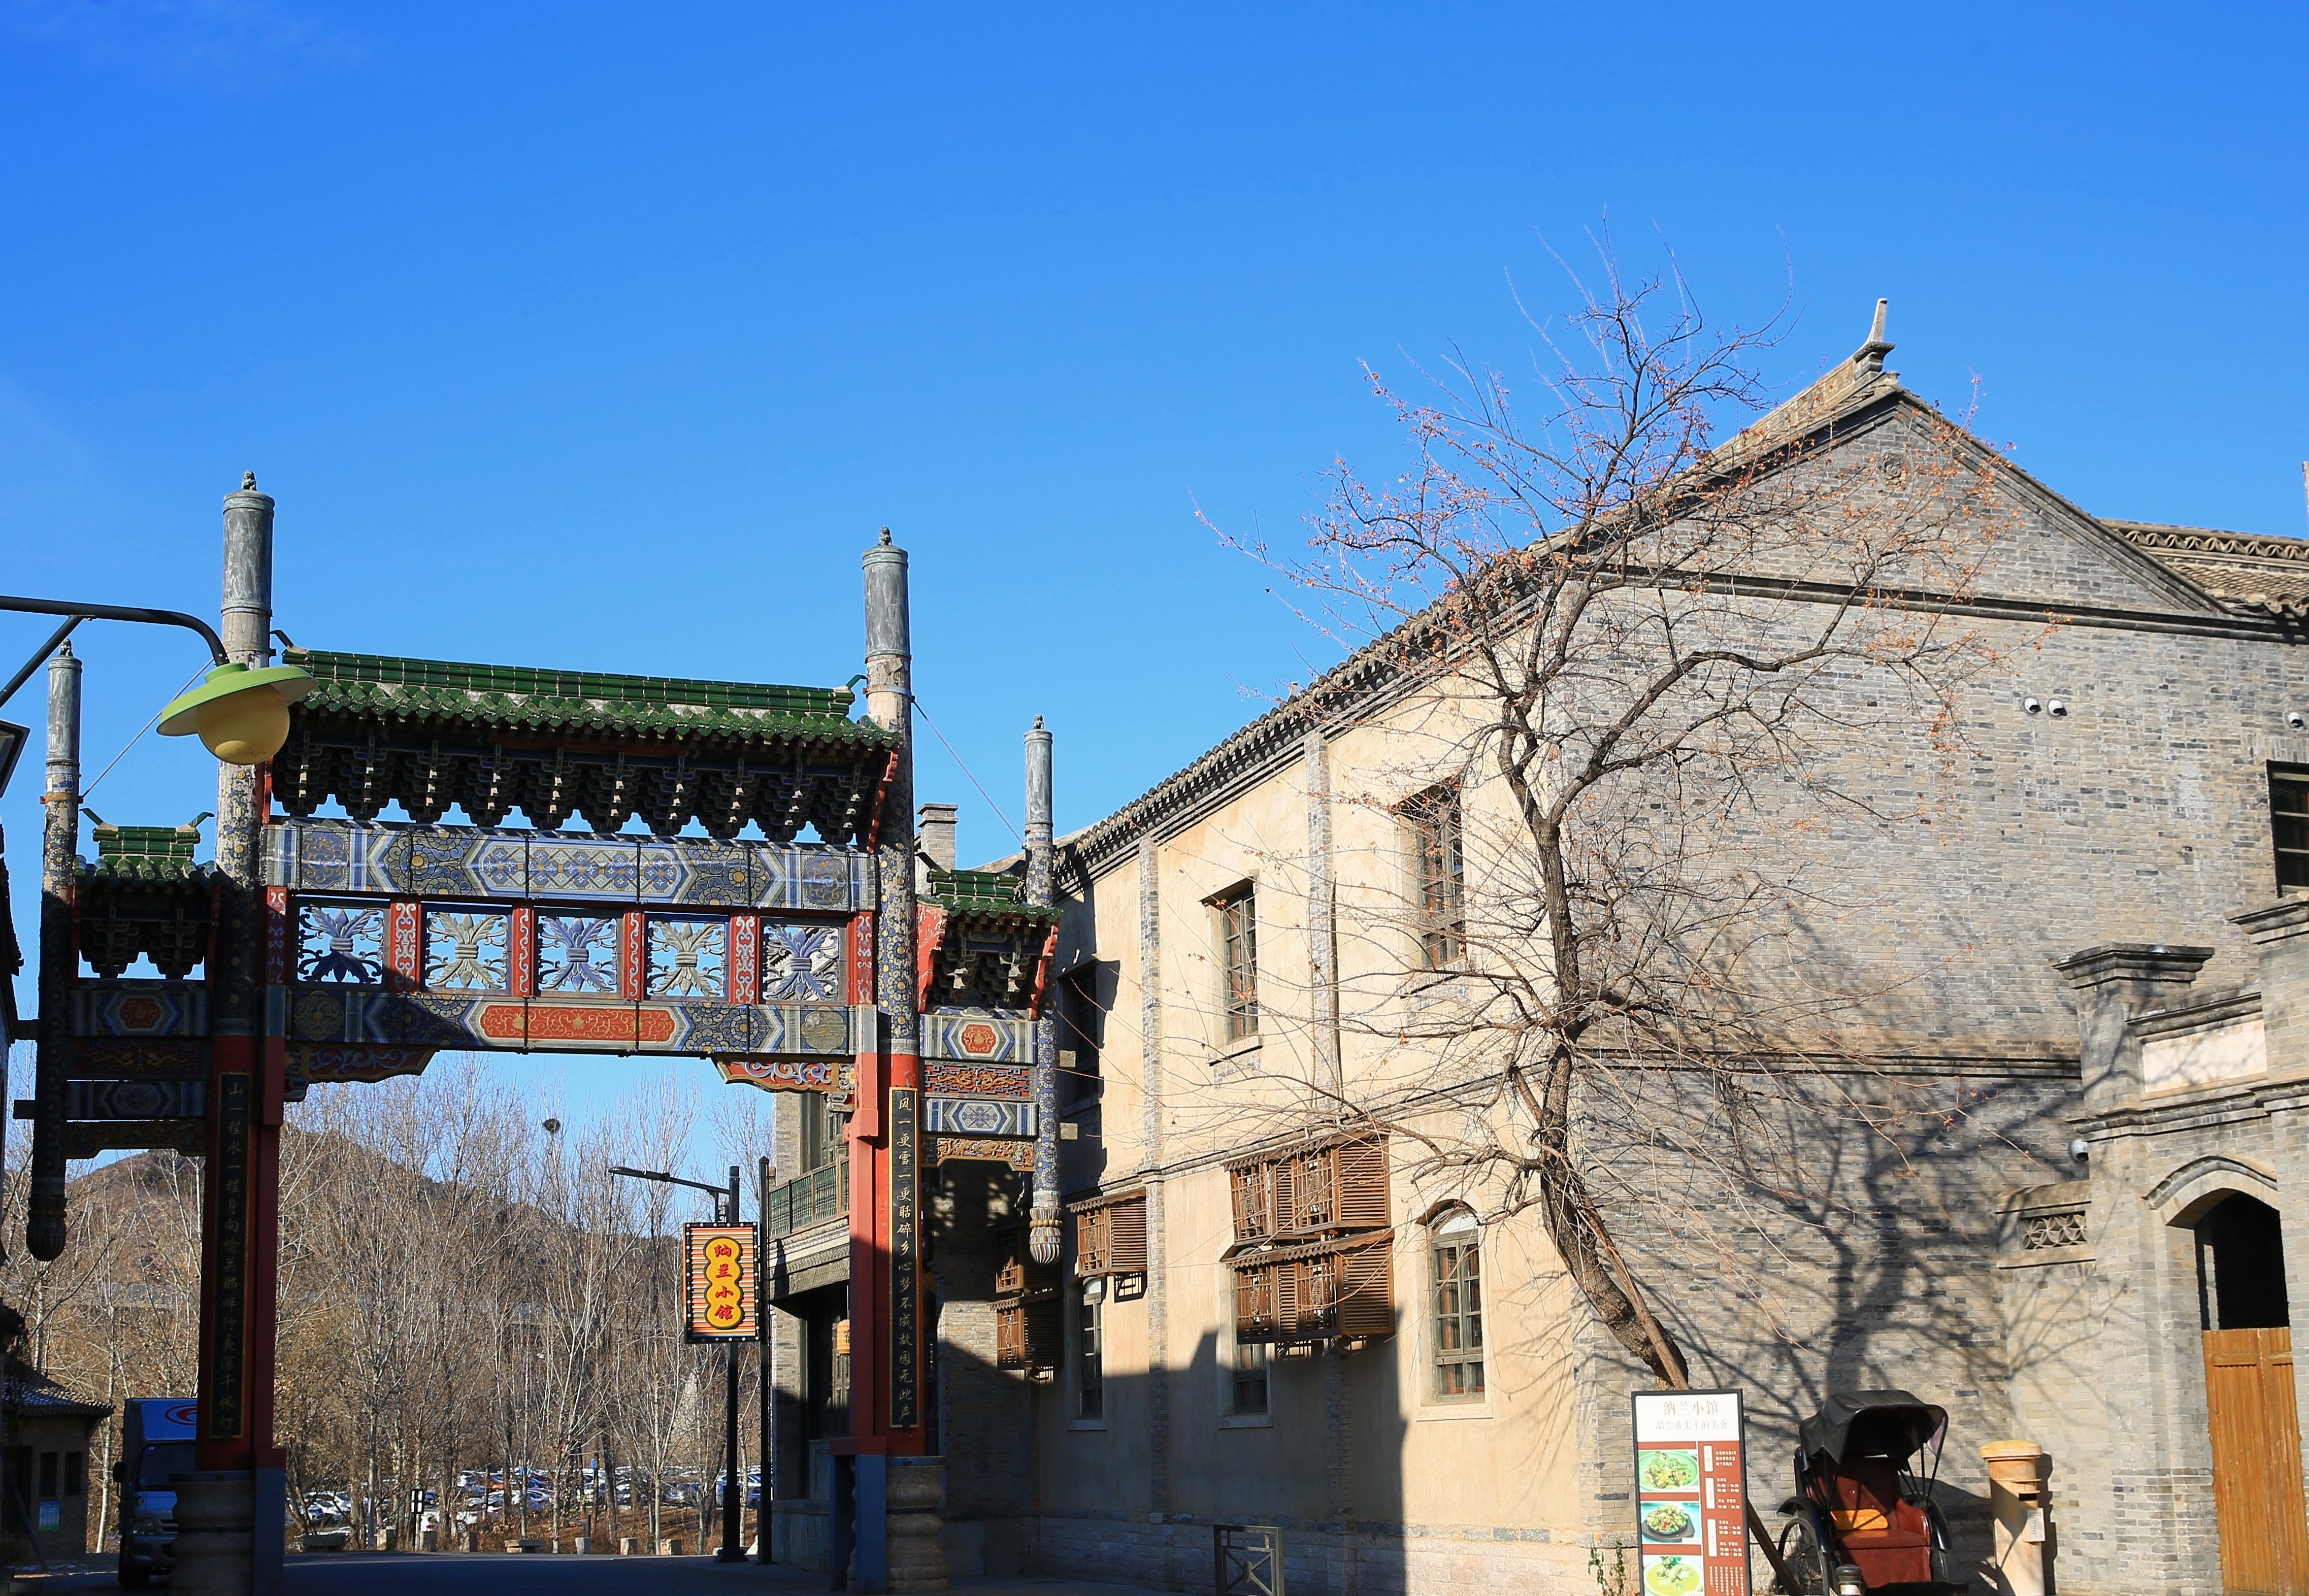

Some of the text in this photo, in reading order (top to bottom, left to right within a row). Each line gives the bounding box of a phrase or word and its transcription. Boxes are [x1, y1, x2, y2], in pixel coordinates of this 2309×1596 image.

[713, 1244, 734, 1320] 纳兰小馆
[897, 1096, 913, 1422] 风一更雪一更聒碎乡心梦不成故园无此声
[1664, 1400, 1719, 1416] 纳兰小馆
